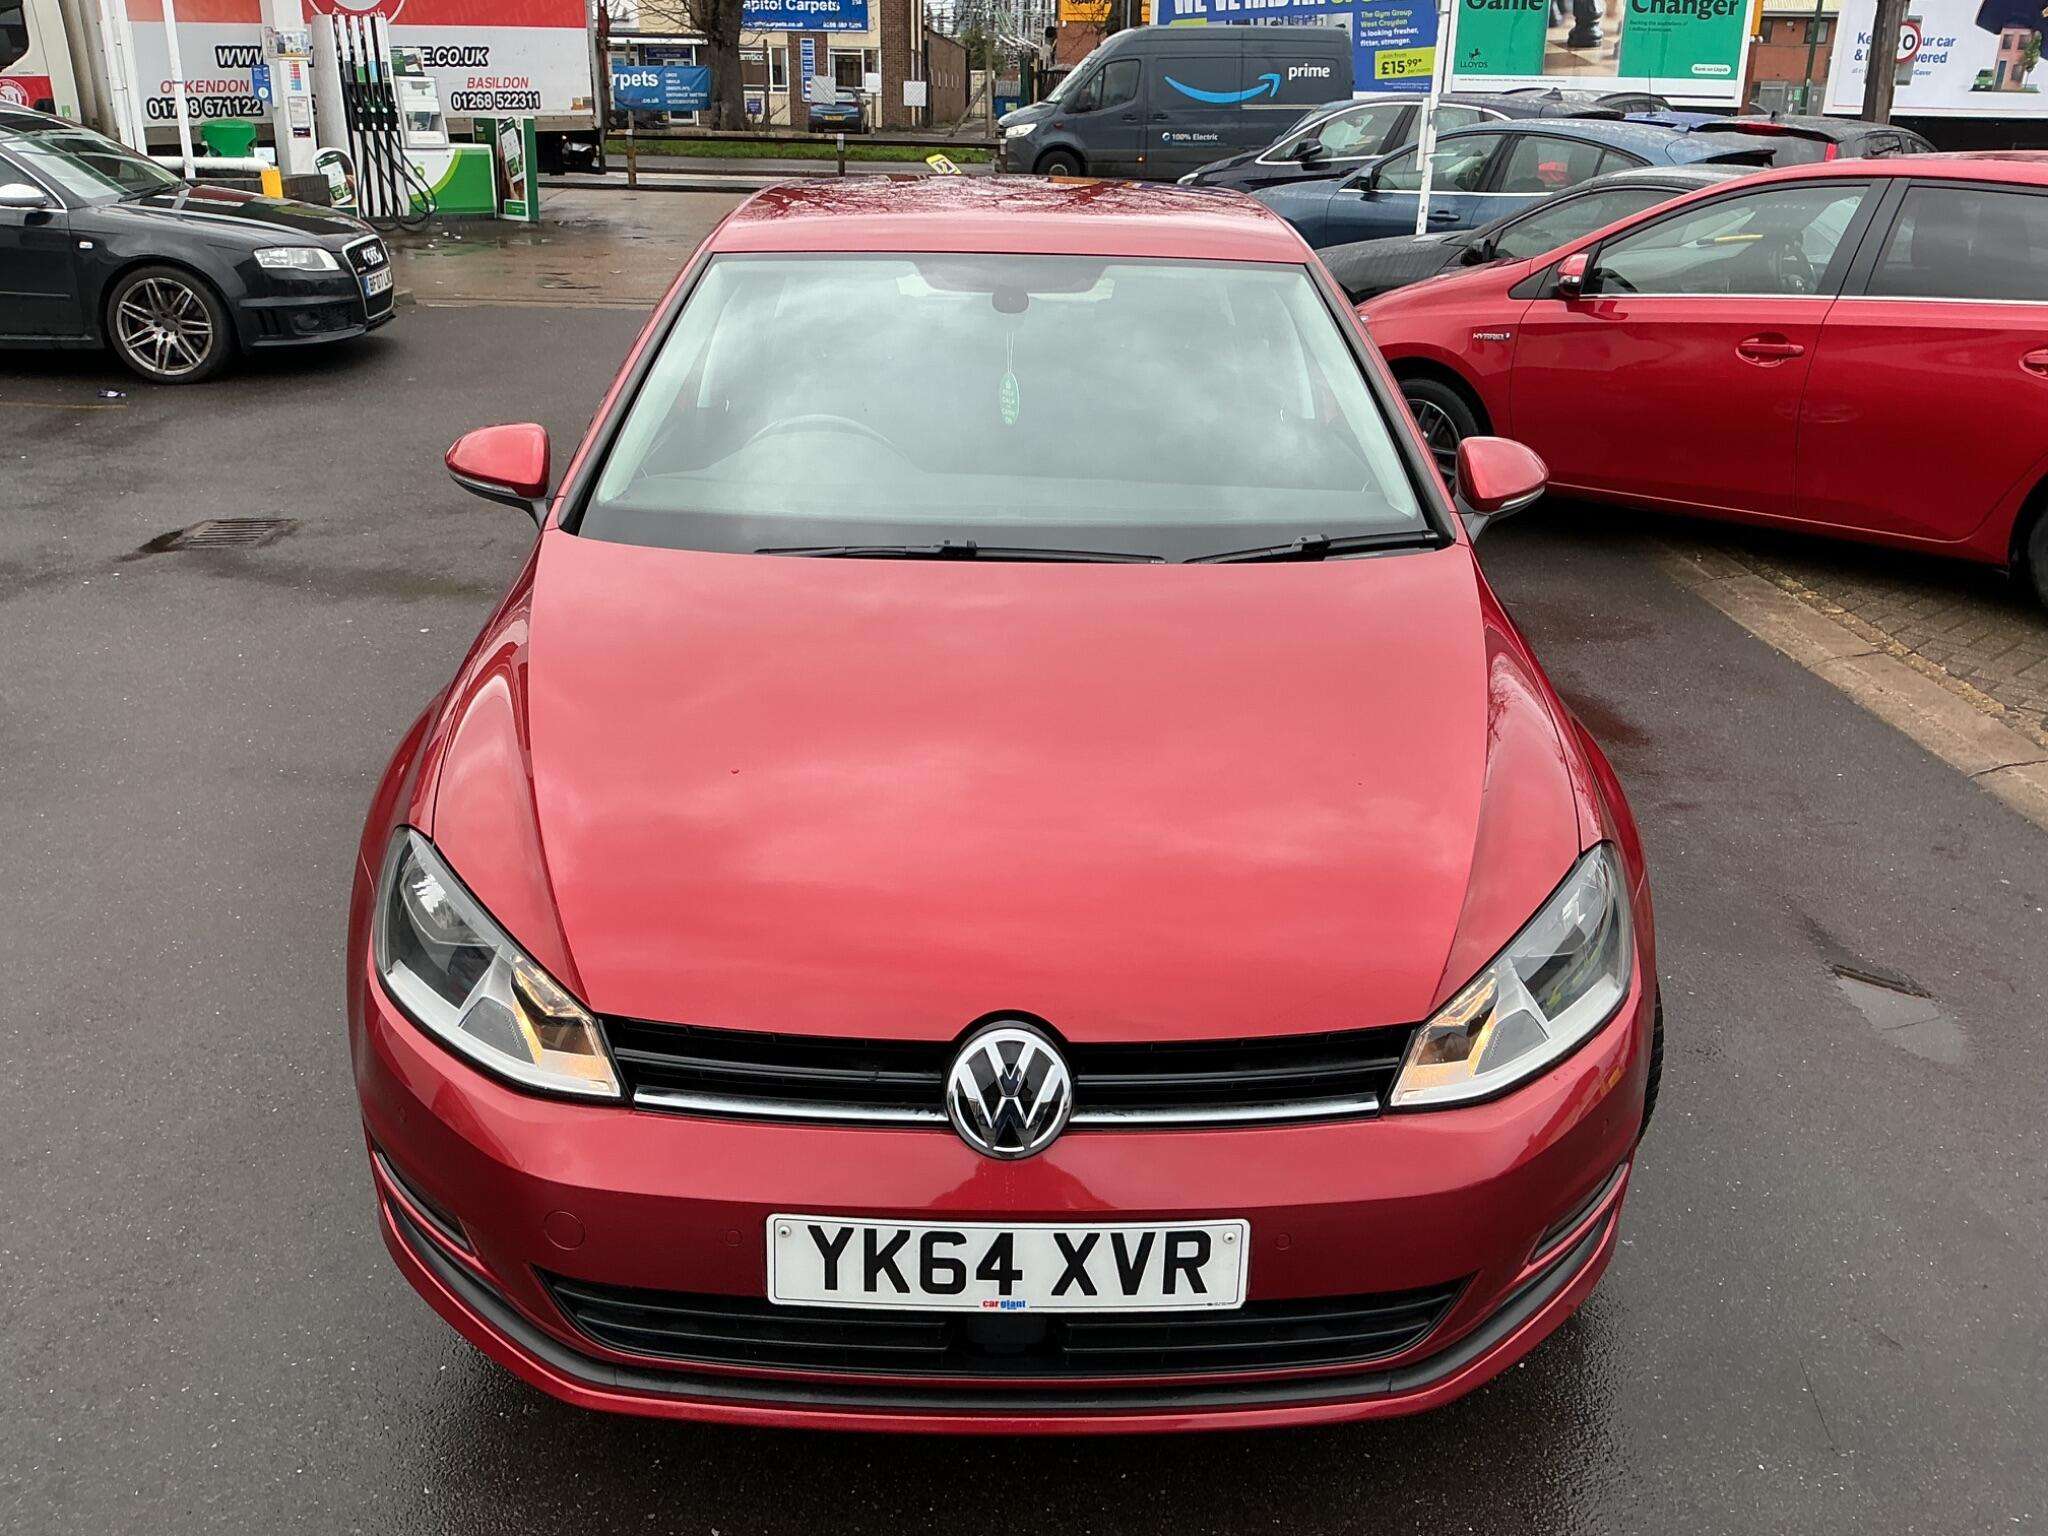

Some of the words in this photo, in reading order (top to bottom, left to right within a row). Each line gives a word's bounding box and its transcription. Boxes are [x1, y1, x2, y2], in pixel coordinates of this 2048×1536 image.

[785, 0, 841, 13] Carpets
[1391, 9, 1413, 17] Group
[1632, 0, 1739, 20] Changer
[1367, 29, 1393, 37] looking
[1393, 27, 1419, 36] fresher,
[1936, 37, 1957, 47] car
[1288, 62, 1331, 80] prime
[160, 80, 251, 94] OKENDON
[466, 77, 530, 89] BASILDON
[451, 91, 494, 110] 01268
[494, 91, 541, 110] 522311
[146, 97, 201, 119] 0178
[201, 96, 264, 118] 671122
[1192, 133, 1218, 141] Electric
[807, 1225, 1024, 1296] YK64
[1051, 1230, 1212, 1296] XVR
